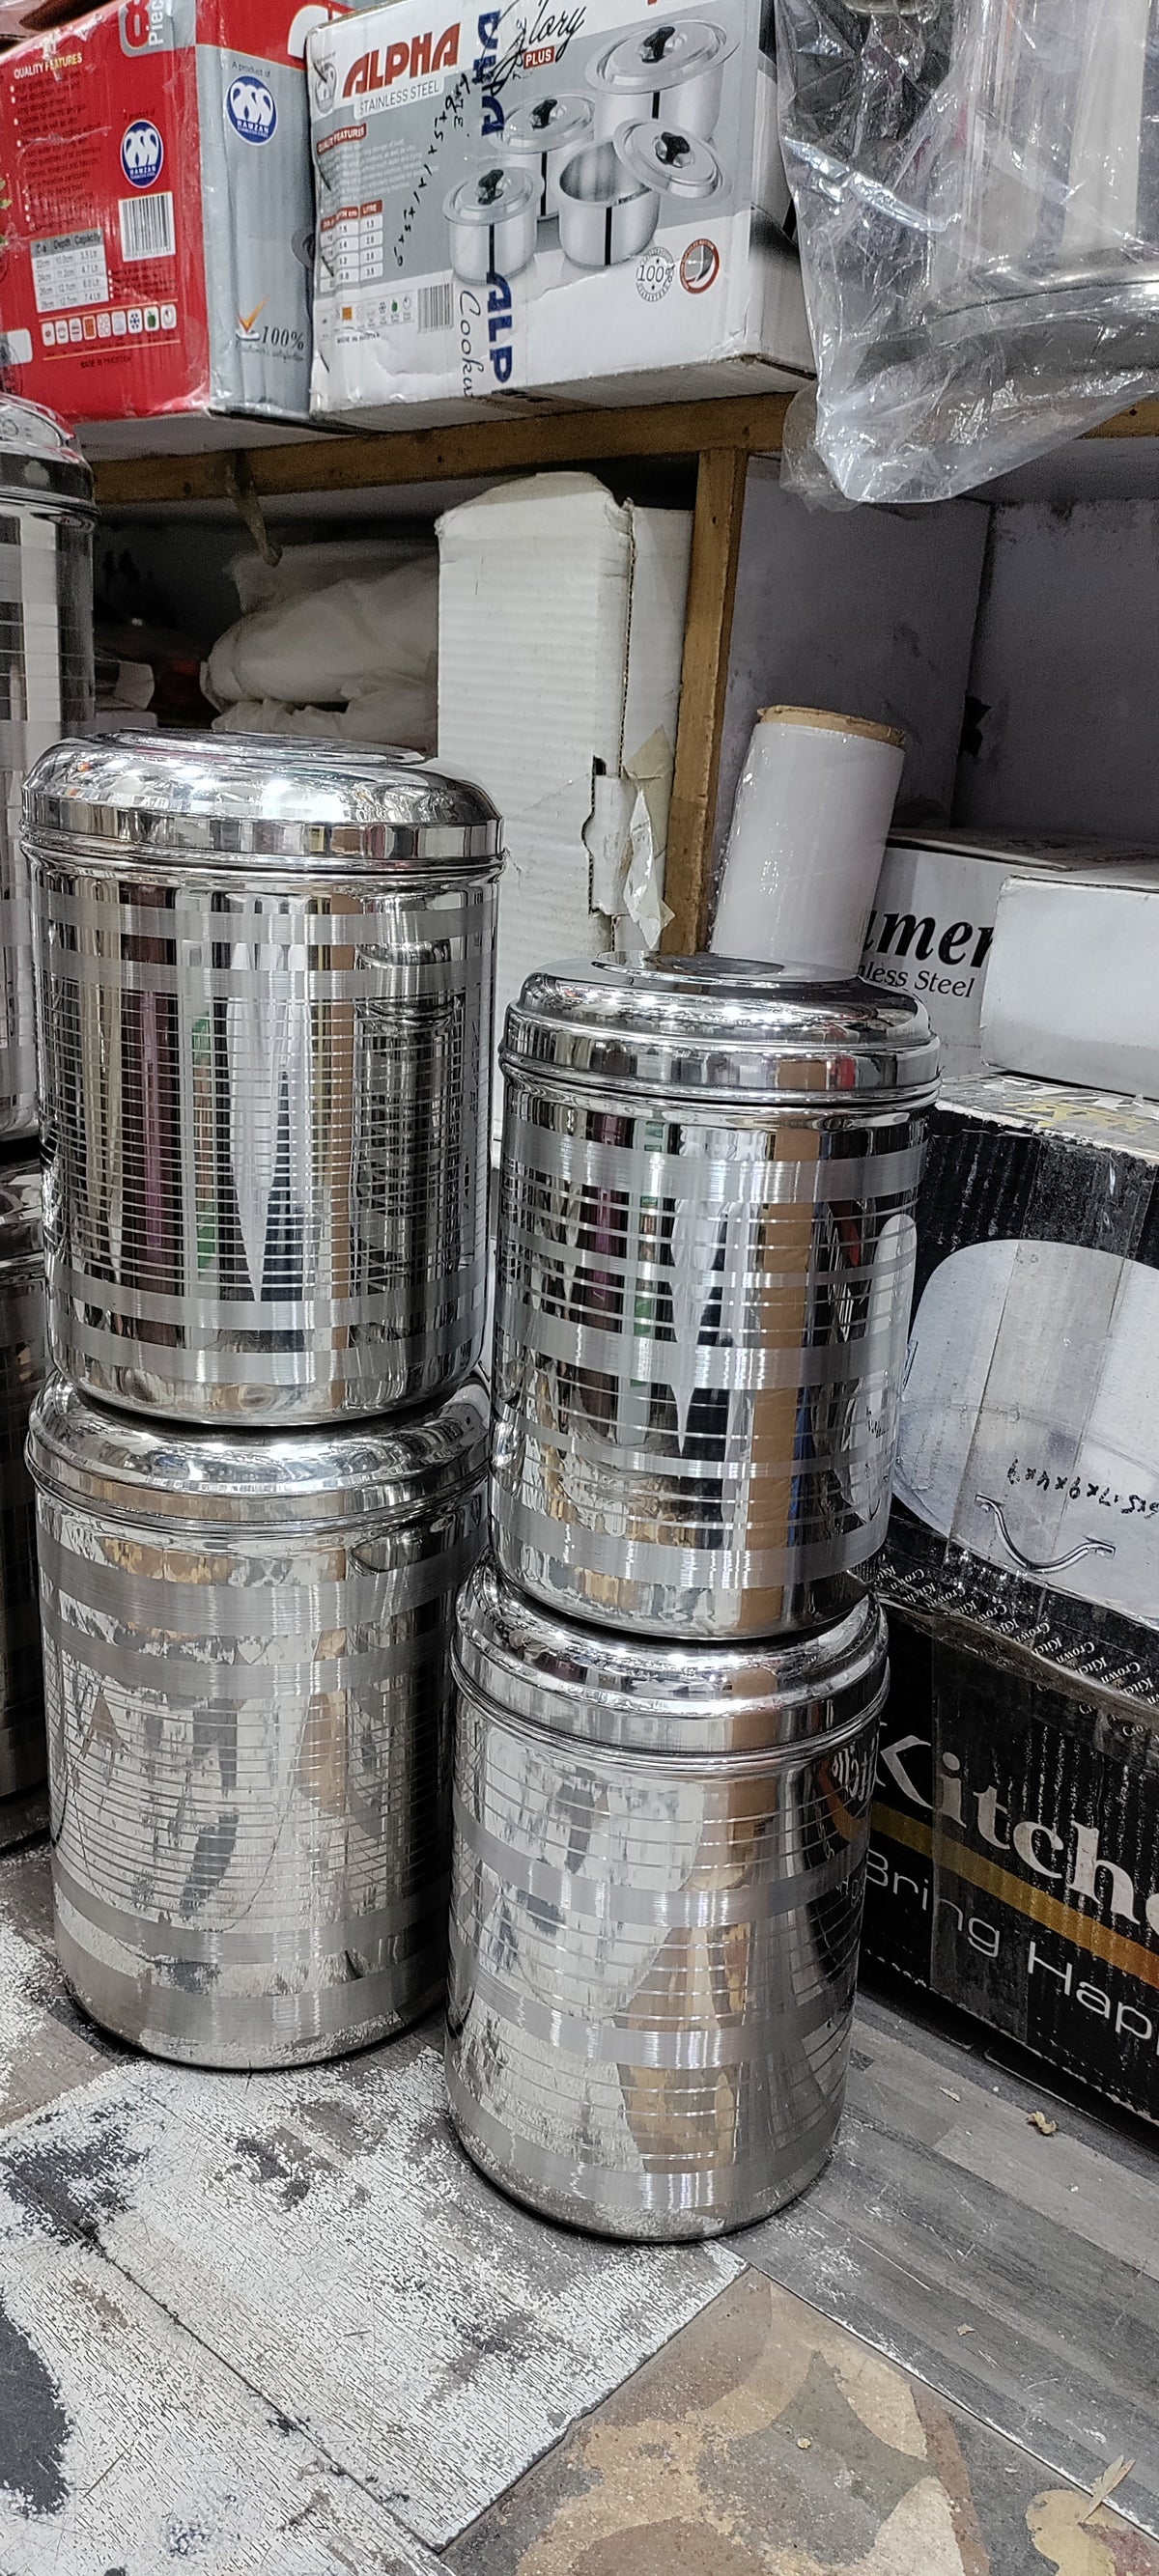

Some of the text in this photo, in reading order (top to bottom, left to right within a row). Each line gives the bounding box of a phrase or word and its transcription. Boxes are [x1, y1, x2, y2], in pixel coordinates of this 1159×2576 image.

[14, 52, 83, 79] QUALITY FEATURES
[342, 23, 462, 98] ALPHA
[525, 49, 552, 67] PLUS
[359, 80, 439, 115] STAINLESS STEEL
[637, 263, 675, 288] 100%
[262, 325, 304, 350] 100%
[915, 970, 975, 997] Steel
[1056, 1641, 1095, 1665] Crown
[1100, 1662, 1141, 1684] Crown
[866, 1848, 1159, 2056] Bring Hap
